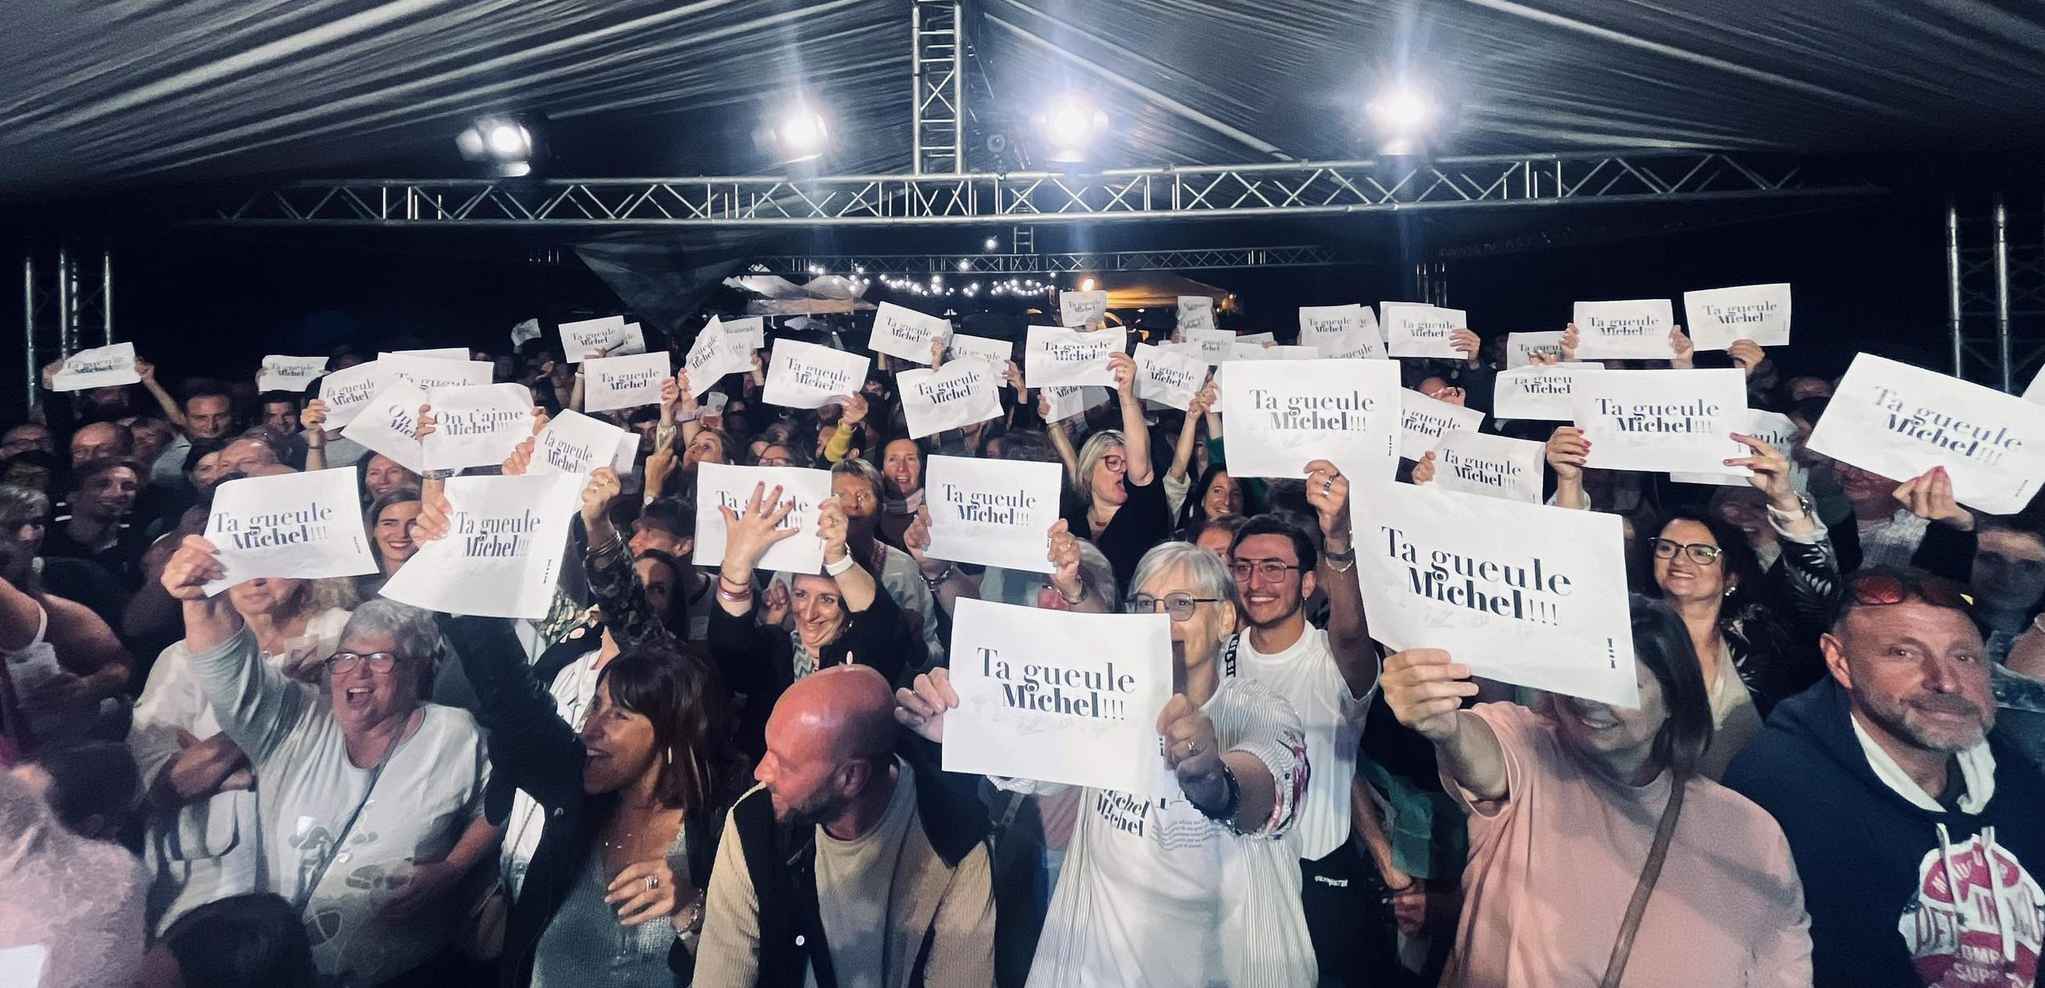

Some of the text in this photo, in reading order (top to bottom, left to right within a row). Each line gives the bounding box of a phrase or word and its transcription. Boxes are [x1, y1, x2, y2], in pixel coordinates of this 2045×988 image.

[1702, 300, 1777, 316] Ta gueule
[1590, 316, 1660, 329] Ta gueule
[600, 367, 659, 383] Ta gueule
[785, 356, 851, 383] Ta gueule
[915, 371, 981, 396] Ta gueule
[1249, 389, 1375, 416] Ta gueule
[1595, 398, 1720, 418] Ta gueule
[1270, 411, 1367, 432] Michel!!!
[1410, 409, 1461, 430] gueule
[1615, 417, 1713, 434] Michel!!!
[1875, 386, 2023, 450] Ta gueule
[557, 438, 593, 463] gueule
[1444, 448, 1522, 476] Ta gueule
[715, 490, 737, 509] Ta
[942, 484, 1037, 510] Ta gueule
[212, 502, 334, 536] Ta gueule
[456, 508, 541, 536] Ta gueule
[956, 504, 1030, 526] Michel!!!
[1381, 526, 1573, 597] Ta gueule
[1408, 566, 1560, 627] Michel!!!
[976, 647, 1137, 694] Ta gueule
[1000, 683, 1126, 722] Michel!!!
